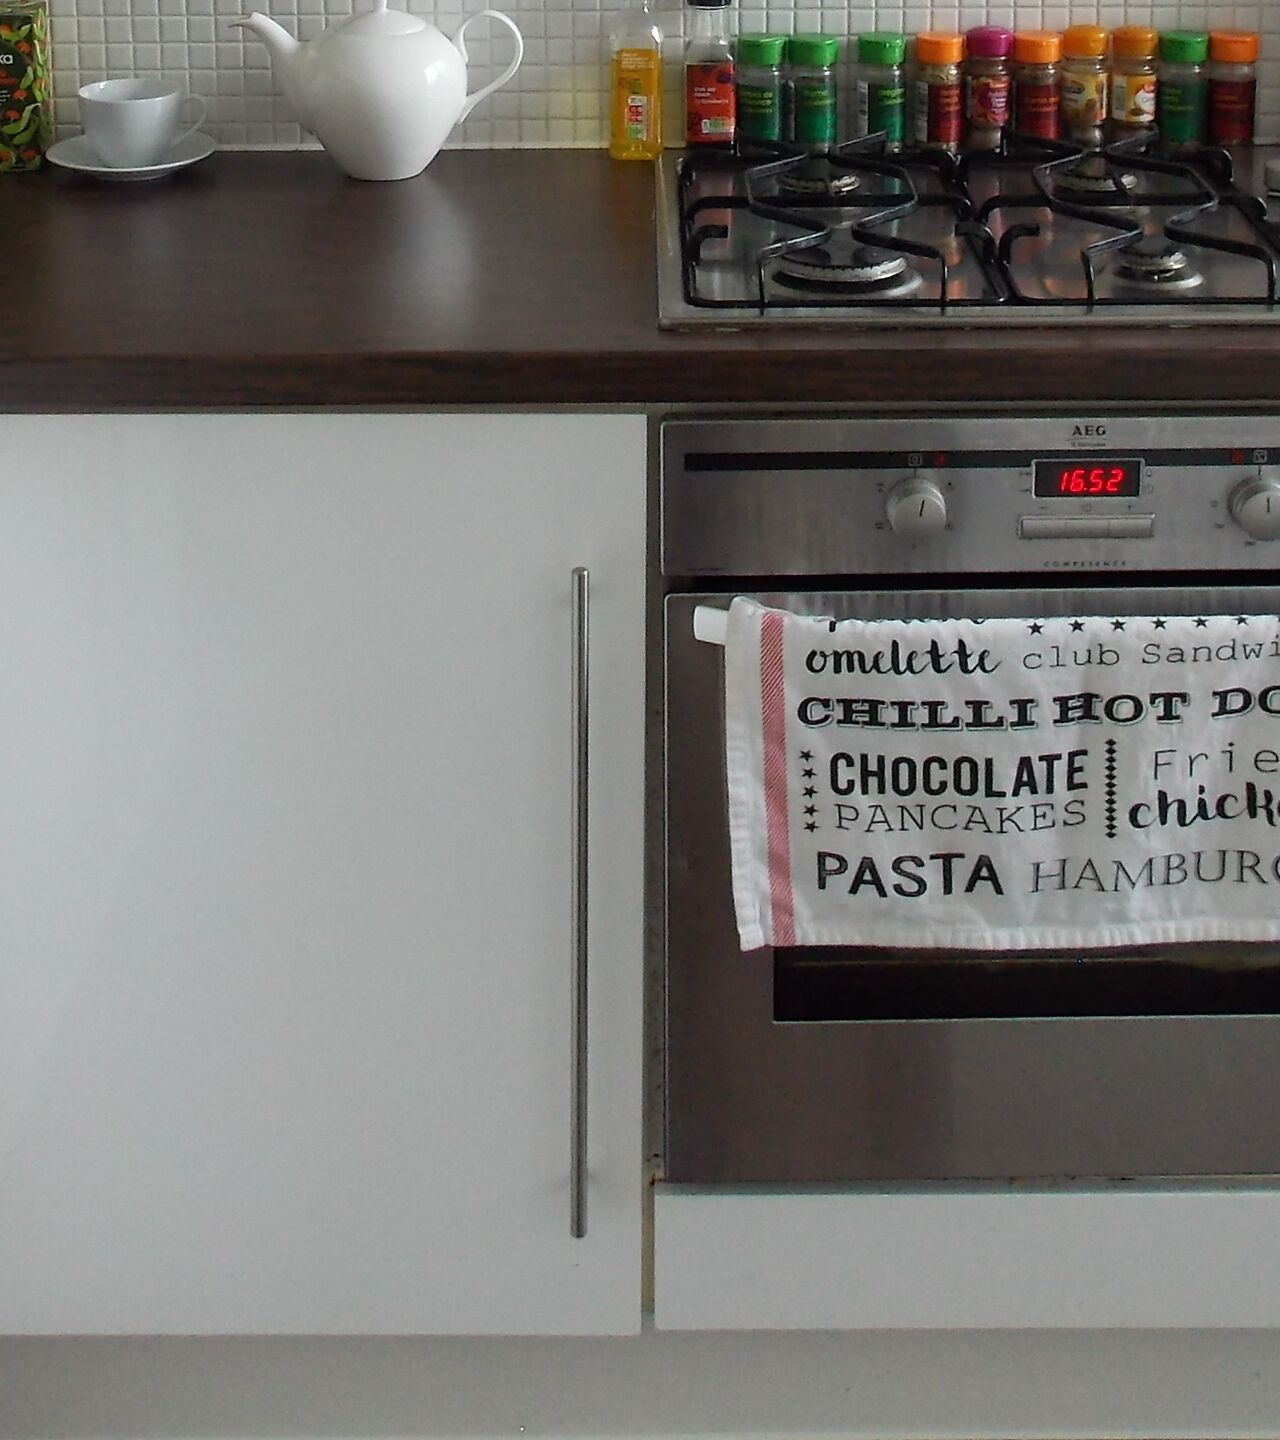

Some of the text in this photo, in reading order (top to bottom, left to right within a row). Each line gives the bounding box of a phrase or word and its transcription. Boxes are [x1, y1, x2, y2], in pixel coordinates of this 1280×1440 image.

[1072, 424, 1106, 436] AEG
[1059, 468, 1124, 493] 16.52
[1043, 560, 1127, 568] COMPETENCE
[805, 638, 1002, 676] omelette
[1022, 643, 1120, 670] club
[797, 695, 1038, 731] CHILLI
[1052, 692, 1190, 726] HOT
[829, 748, 1089, 798] CHOCOLATE
[834, 799, 1087, 834] PANCAKES
[817, 850, 1004, 898] PASTA
